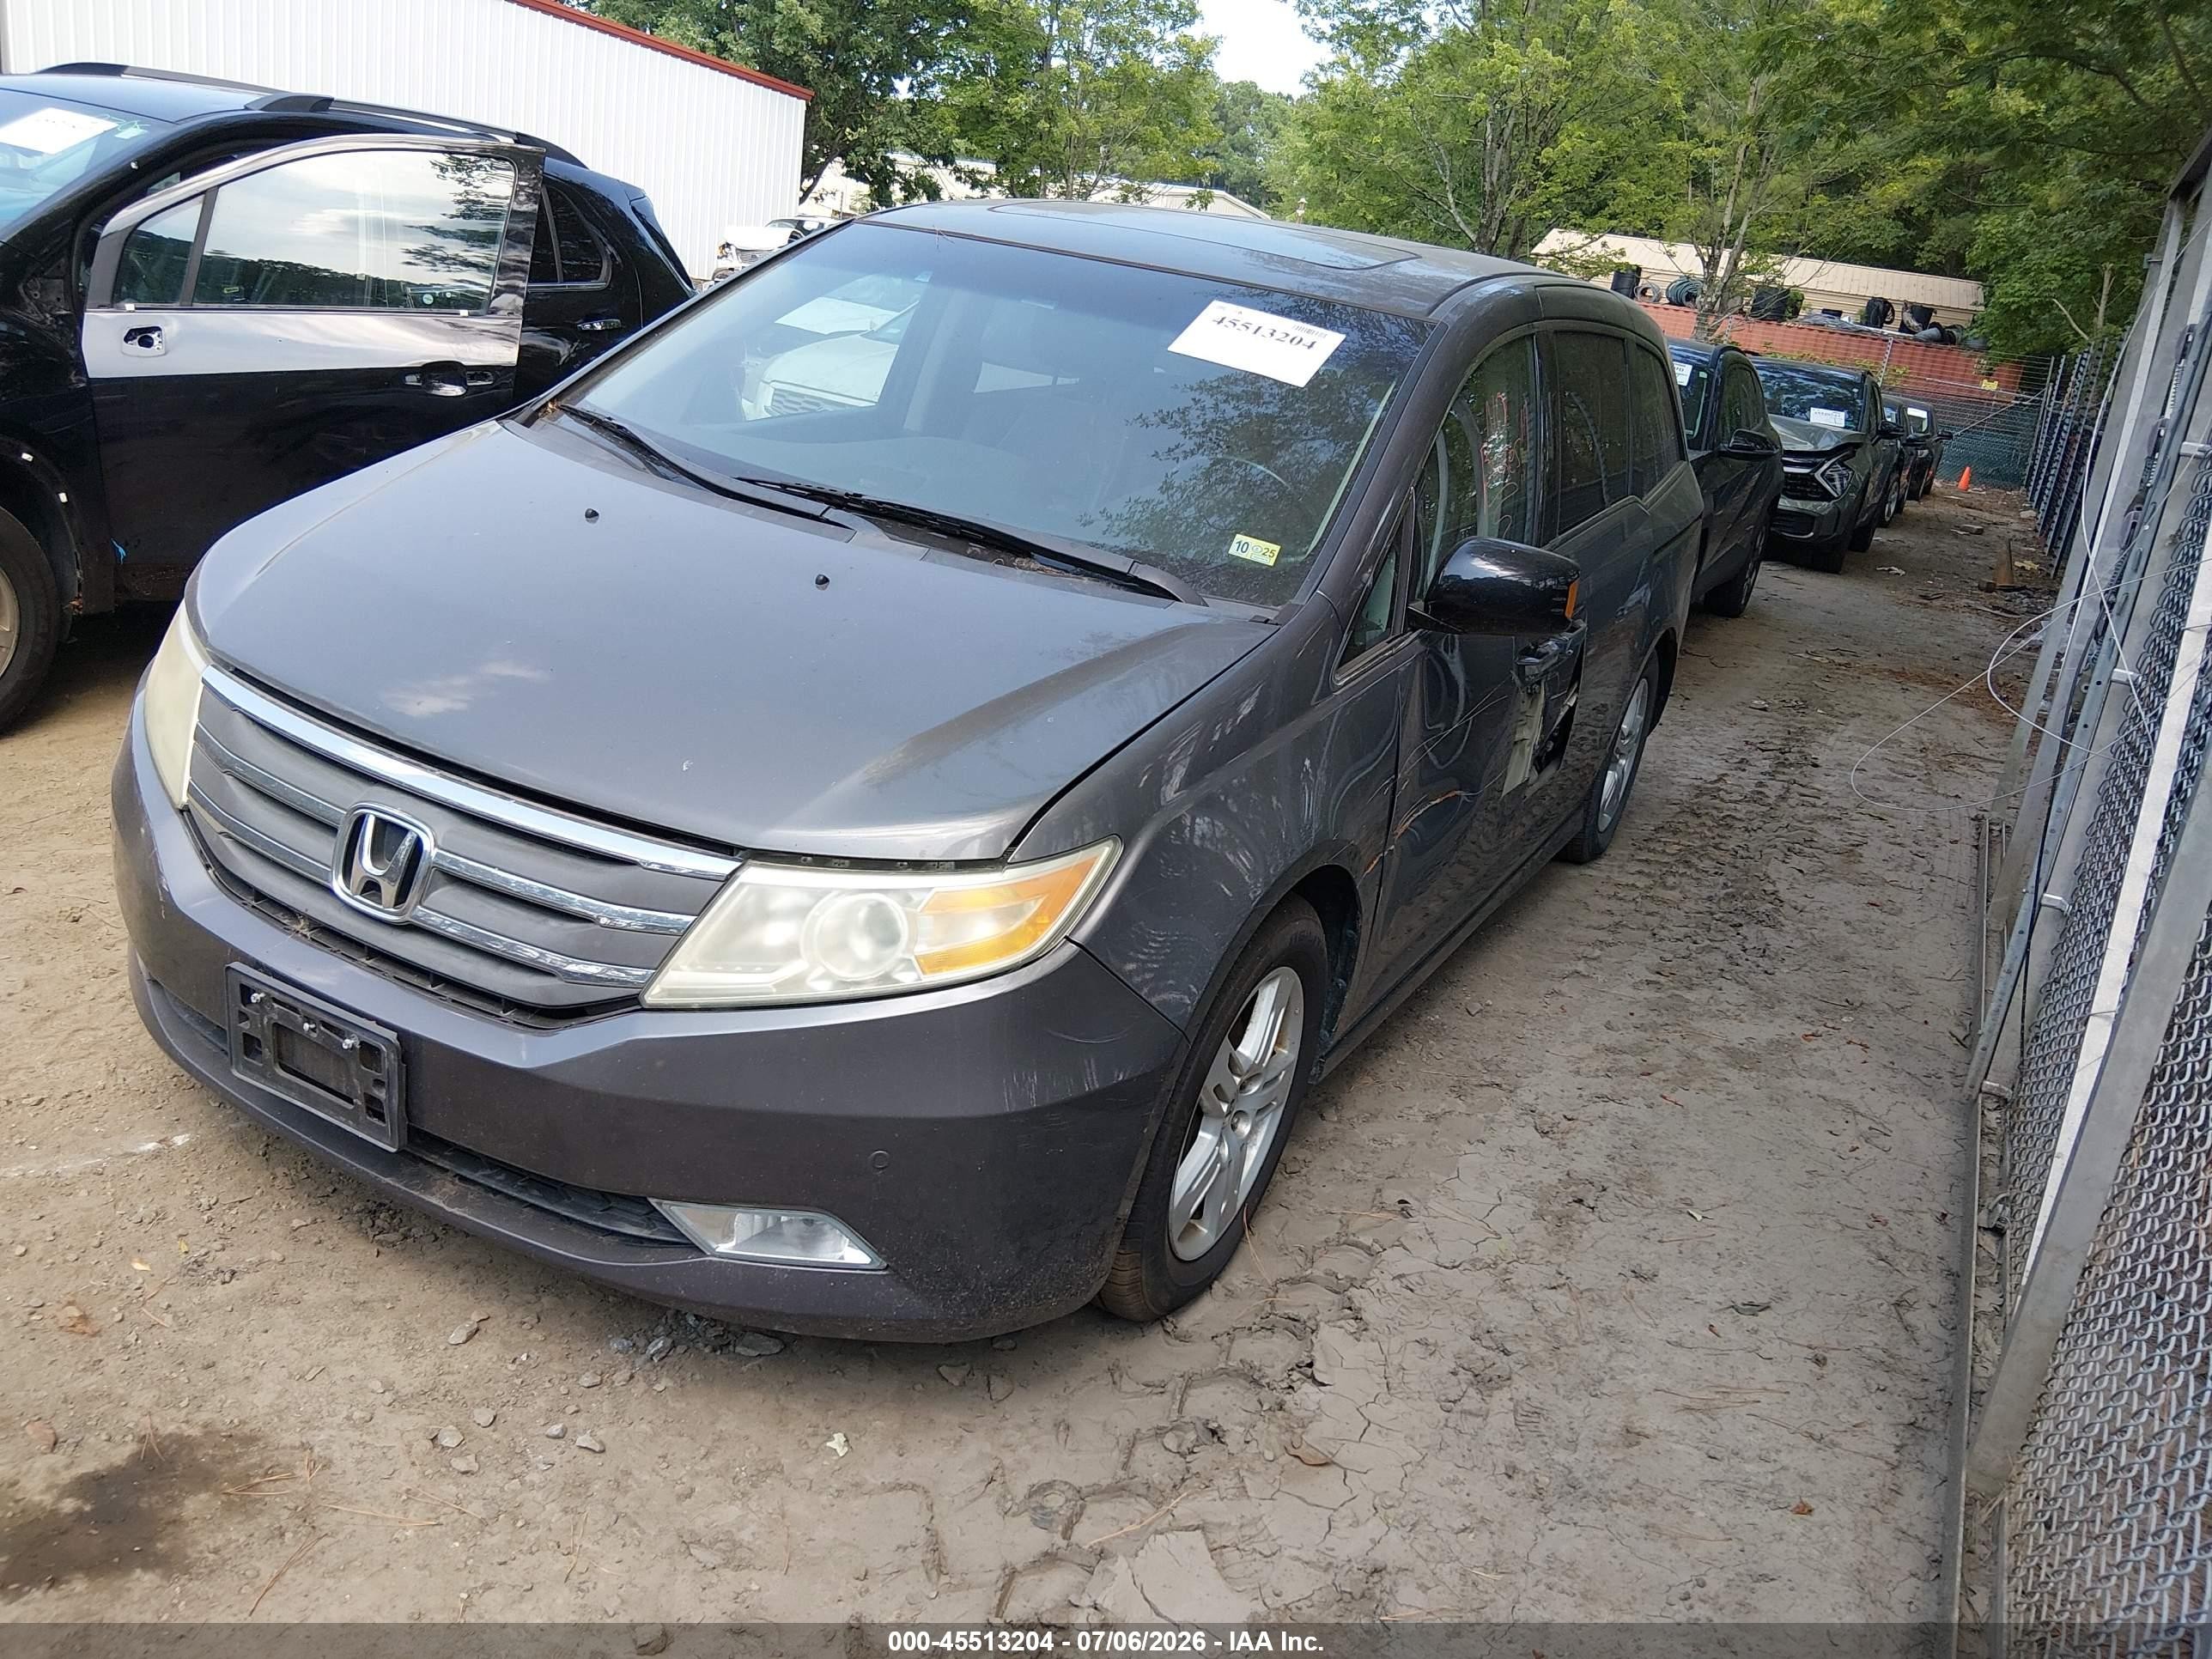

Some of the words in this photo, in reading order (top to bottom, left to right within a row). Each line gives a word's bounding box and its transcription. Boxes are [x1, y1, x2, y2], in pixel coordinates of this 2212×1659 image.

[1212, 315, 1317, 350] 45513204
[1236, 540, 1250, 554] 10
[1262, 547, 1277, 558] 25
